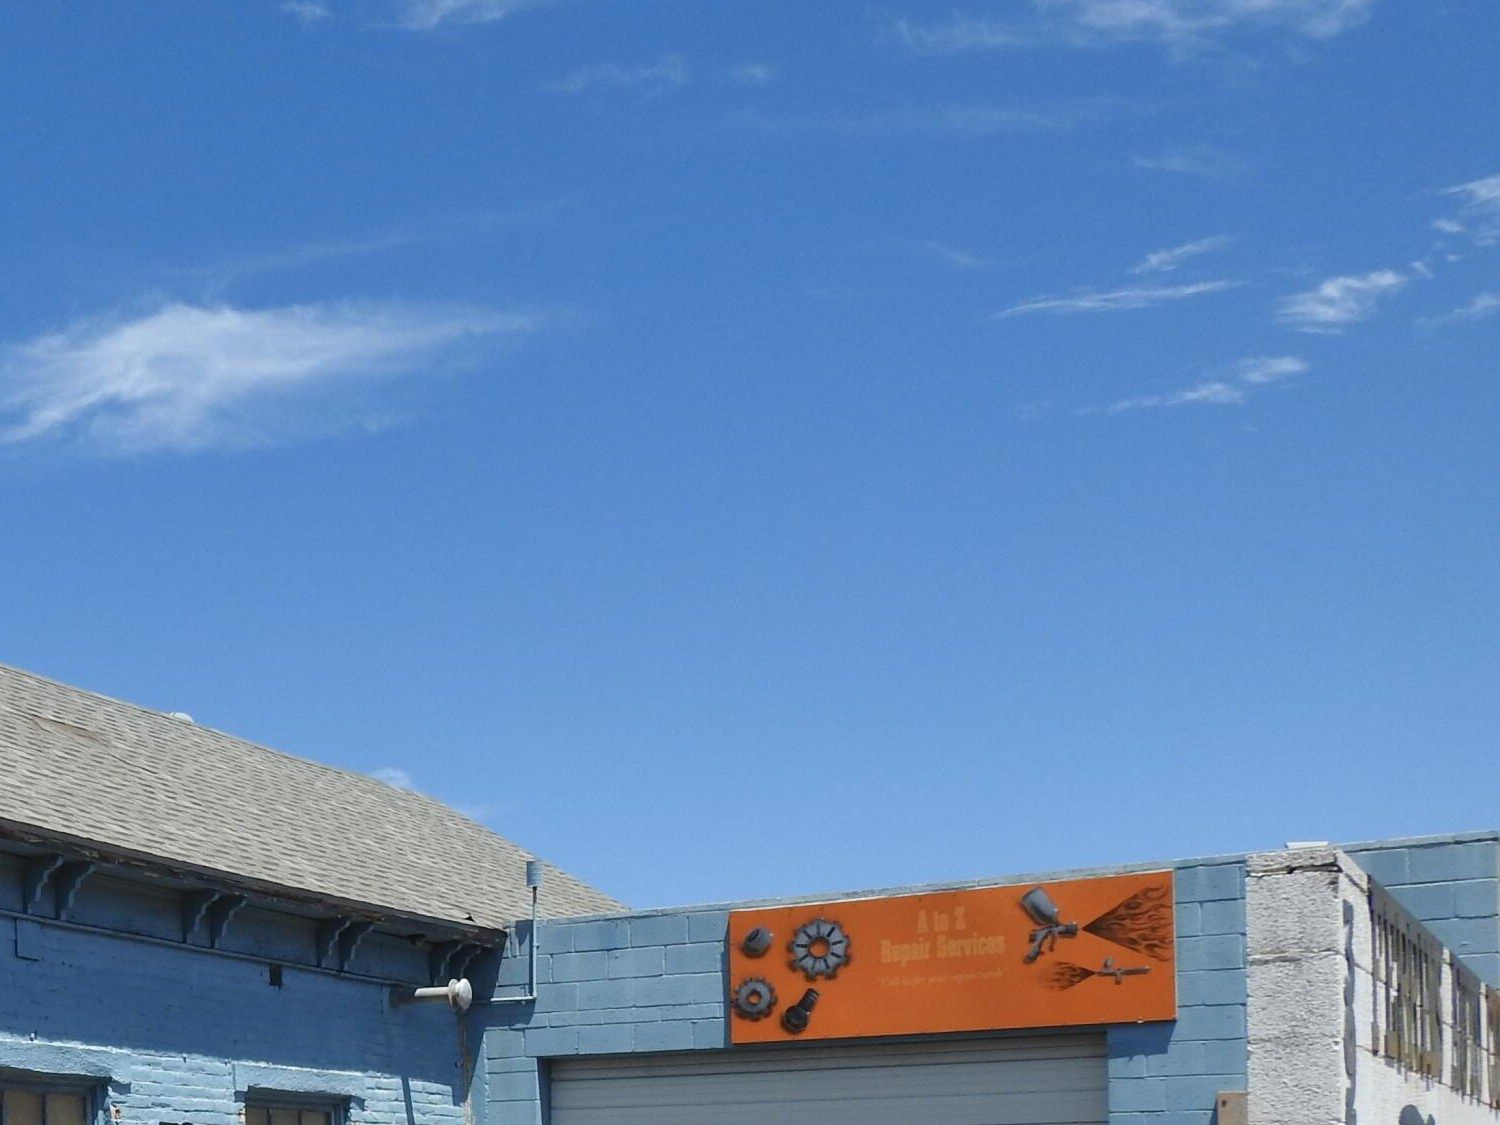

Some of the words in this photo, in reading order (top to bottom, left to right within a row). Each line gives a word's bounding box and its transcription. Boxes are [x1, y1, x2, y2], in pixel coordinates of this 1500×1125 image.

[917, 910, 929, 933] A
[933, 910, 949, 932] to
[880, 936, 932, 967] Repair
[936, 932, 1005, 958] Services
